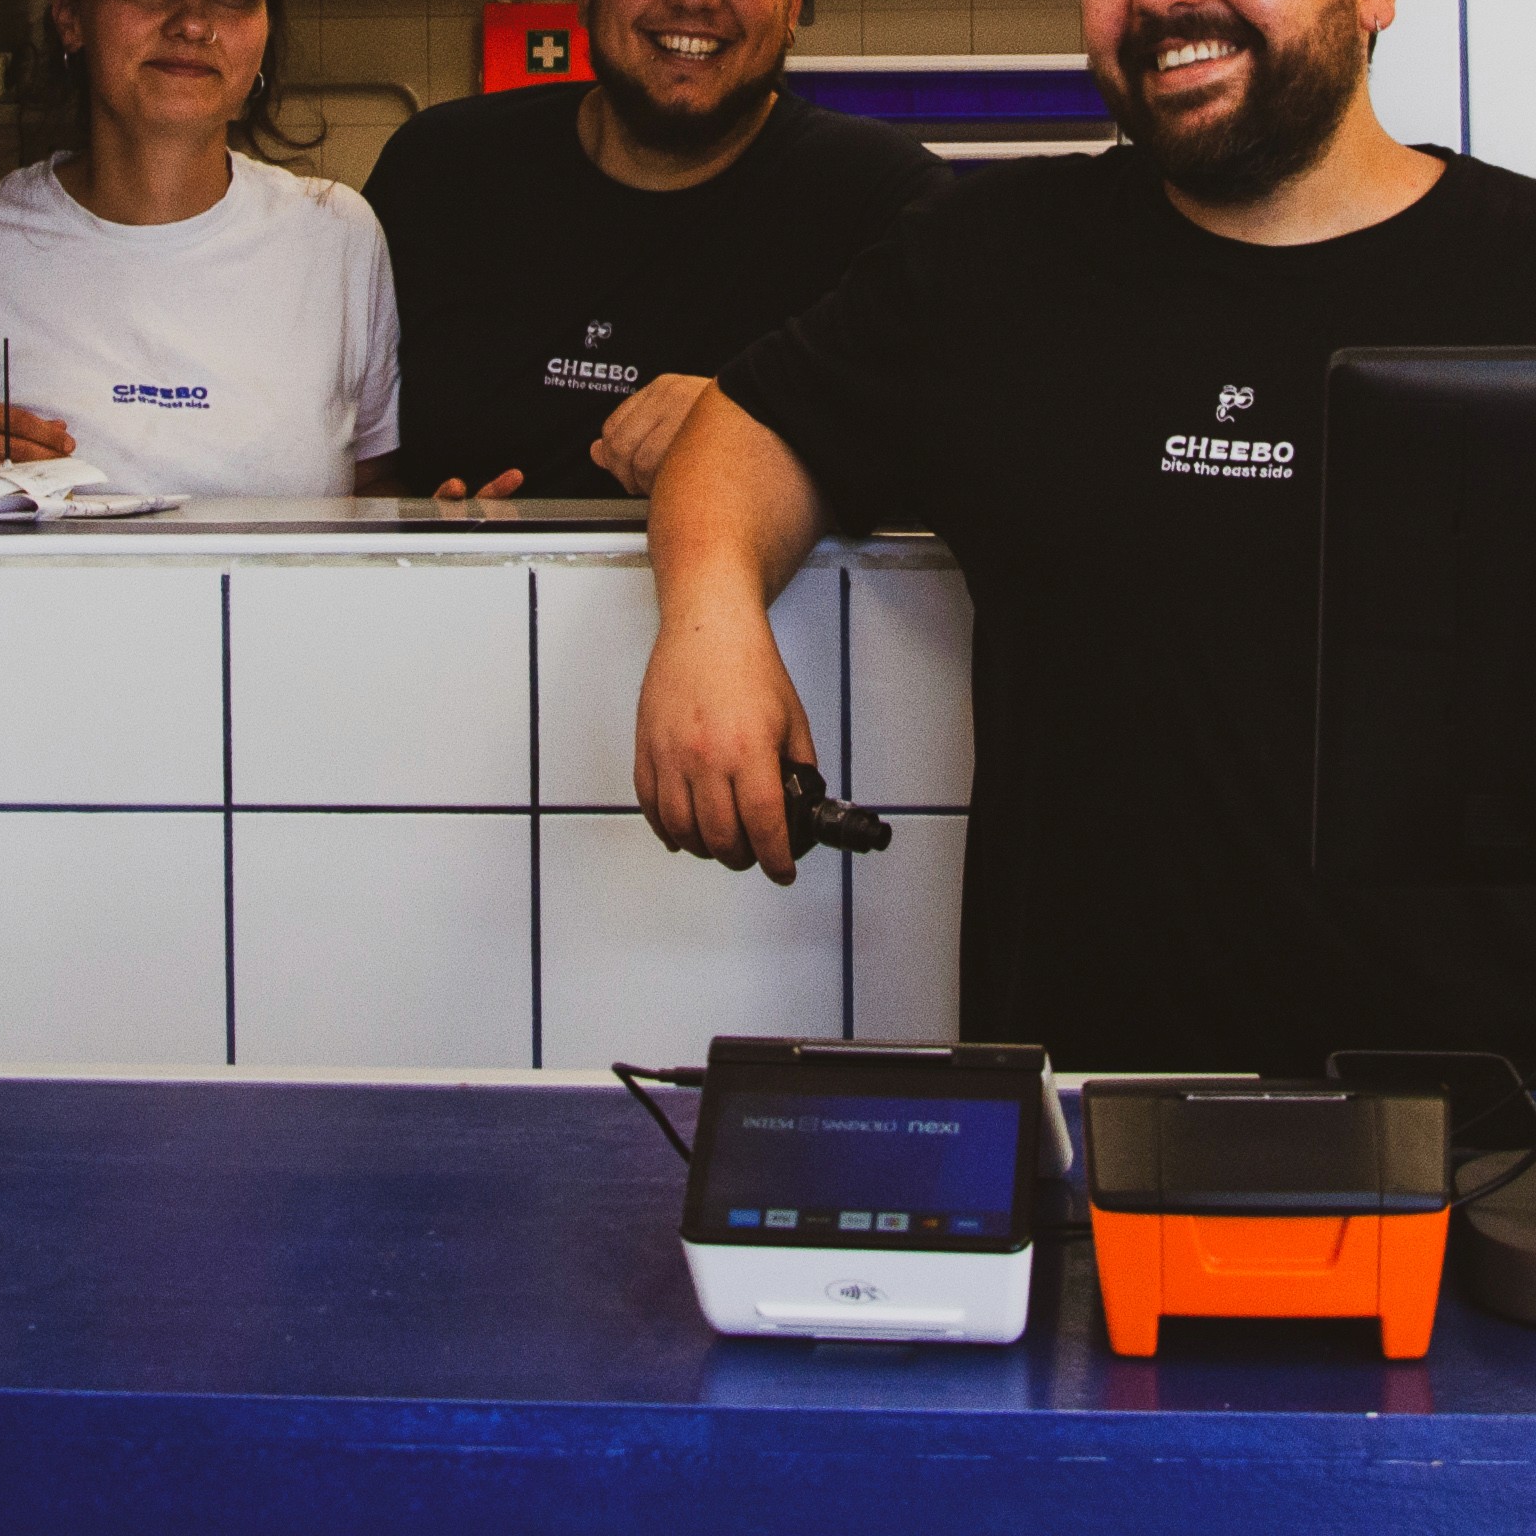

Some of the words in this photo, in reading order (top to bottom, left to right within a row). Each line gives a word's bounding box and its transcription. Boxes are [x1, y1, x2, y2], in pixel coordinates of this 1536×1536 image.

[547, 358, 639, 382] CHEEBO
[567, 378, 586, 389] the
[588, 381, 612, 392] east
[1165, 435, 1295, 463] CHEEBO
[1161, 457, 1190, 473] bite
[1194, 462, 1220, 476] the
[1222, 465, 1257, 478] east
[1259, 463, 1293, 479] side
